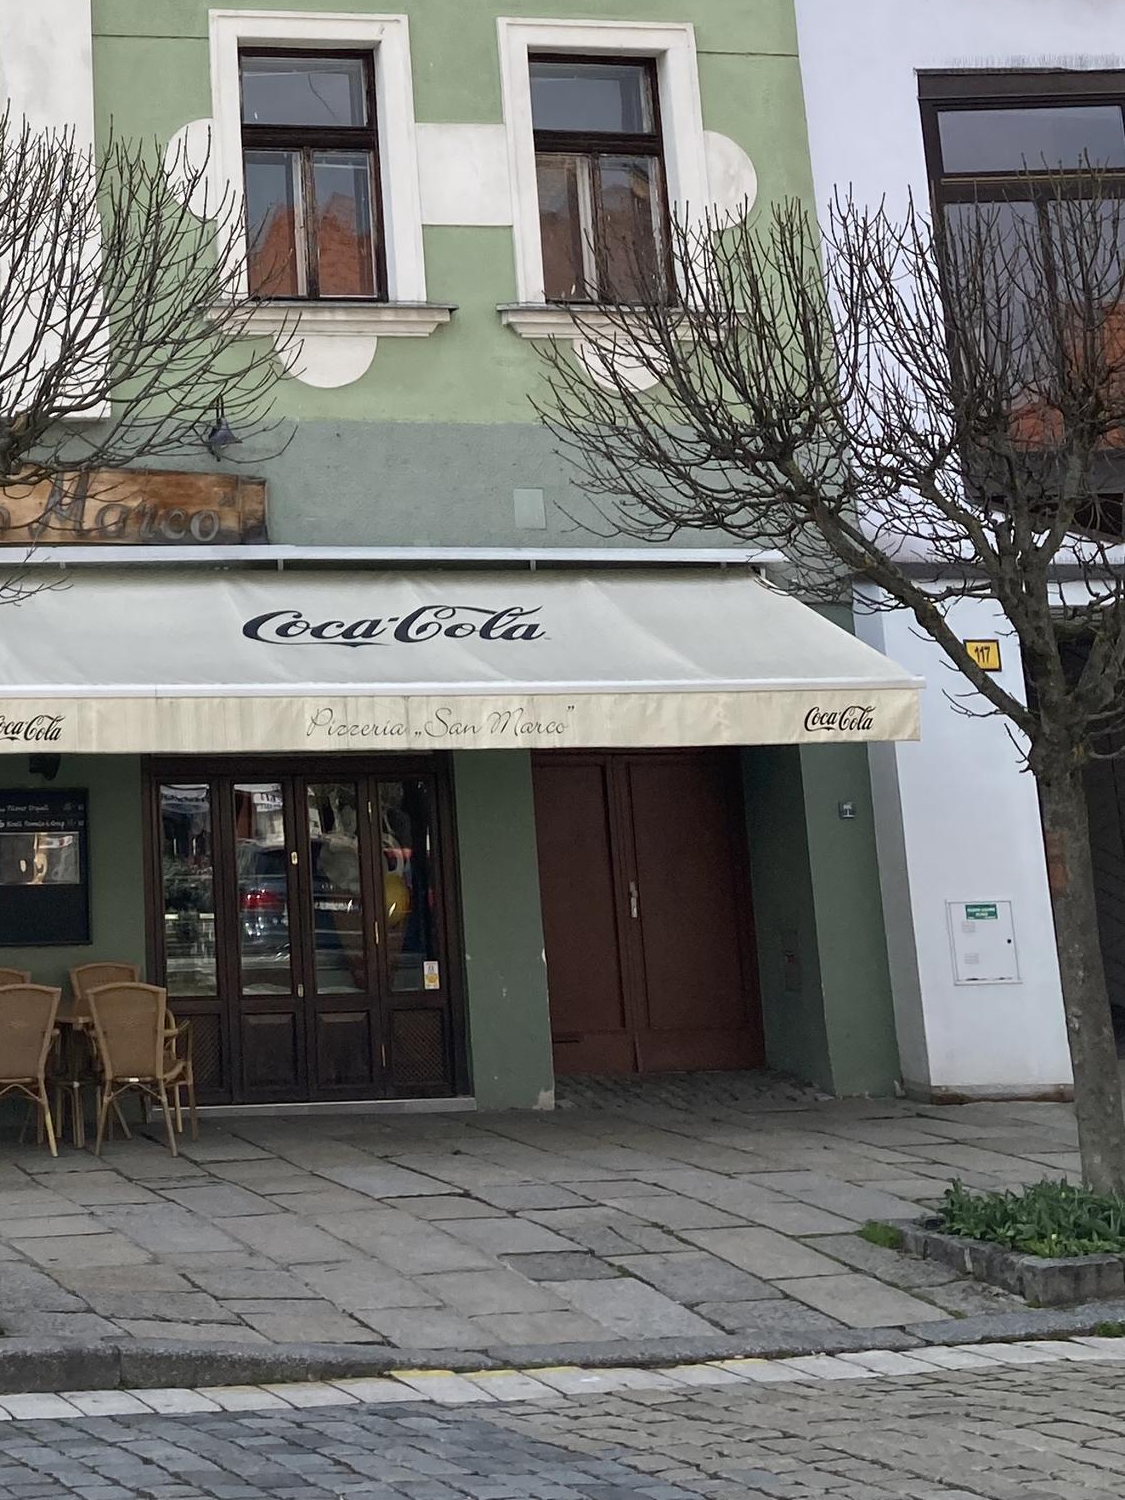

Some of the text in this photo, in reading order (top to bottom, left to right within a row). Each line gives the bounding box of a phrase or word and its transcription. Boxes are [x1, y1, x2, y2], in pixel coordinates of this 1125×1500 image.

[242, 605, 547, 647] Coca-Cola
[974, 646, 991, 663] 117
[306, 707, 405, 737] Pizzeria
[804, 705, 877, 732] Coca-Cola
